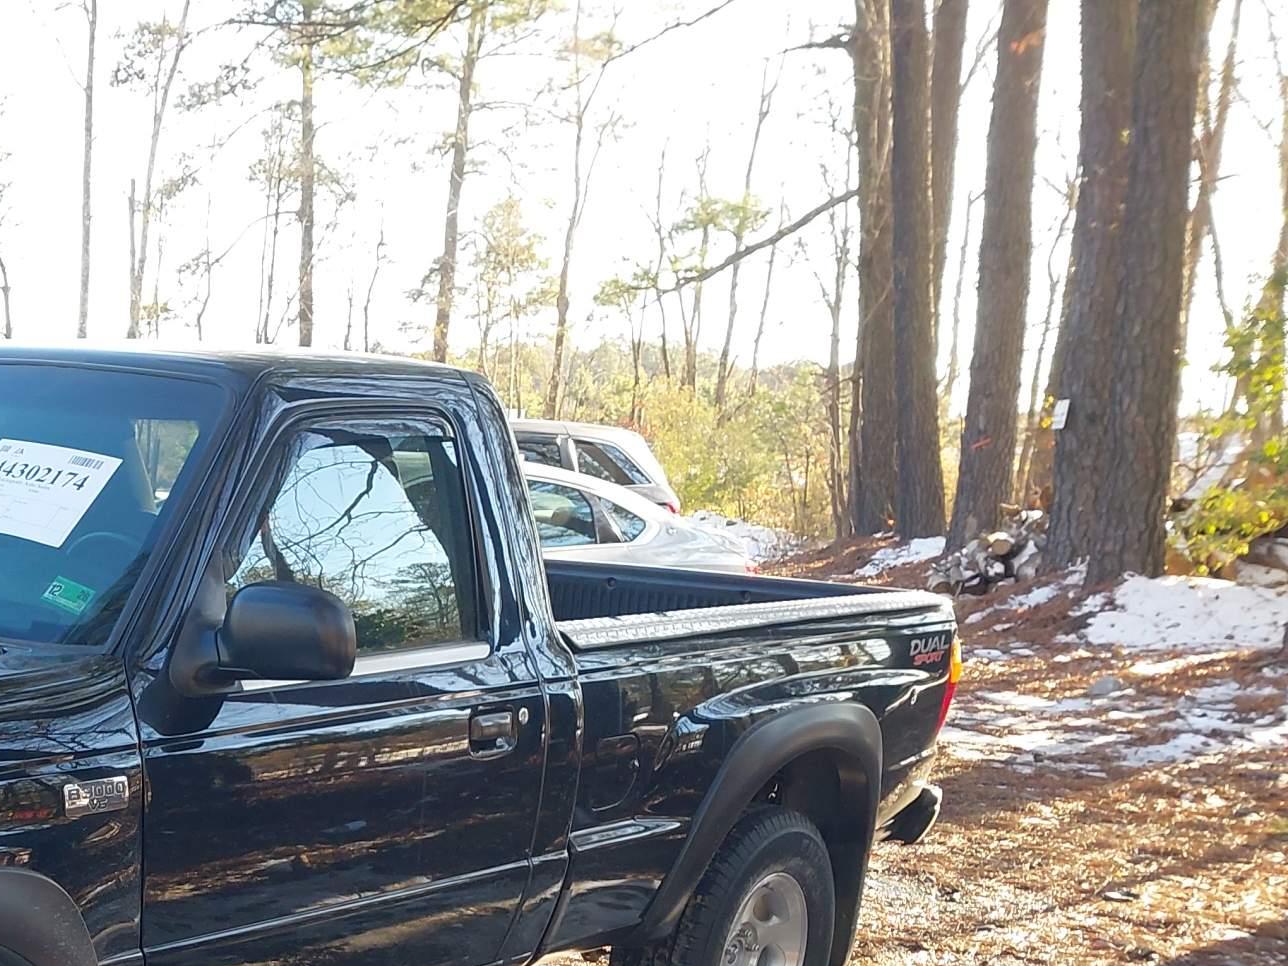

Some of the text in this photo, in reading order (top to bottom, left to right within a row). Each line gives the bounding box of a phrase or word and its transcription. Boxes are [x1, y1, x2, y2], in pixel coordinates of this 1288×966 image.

[48, 584, 63, 597] 12
[910, 635, 950, 656] DUAL
[913, 651, 944, 666] SPORT
